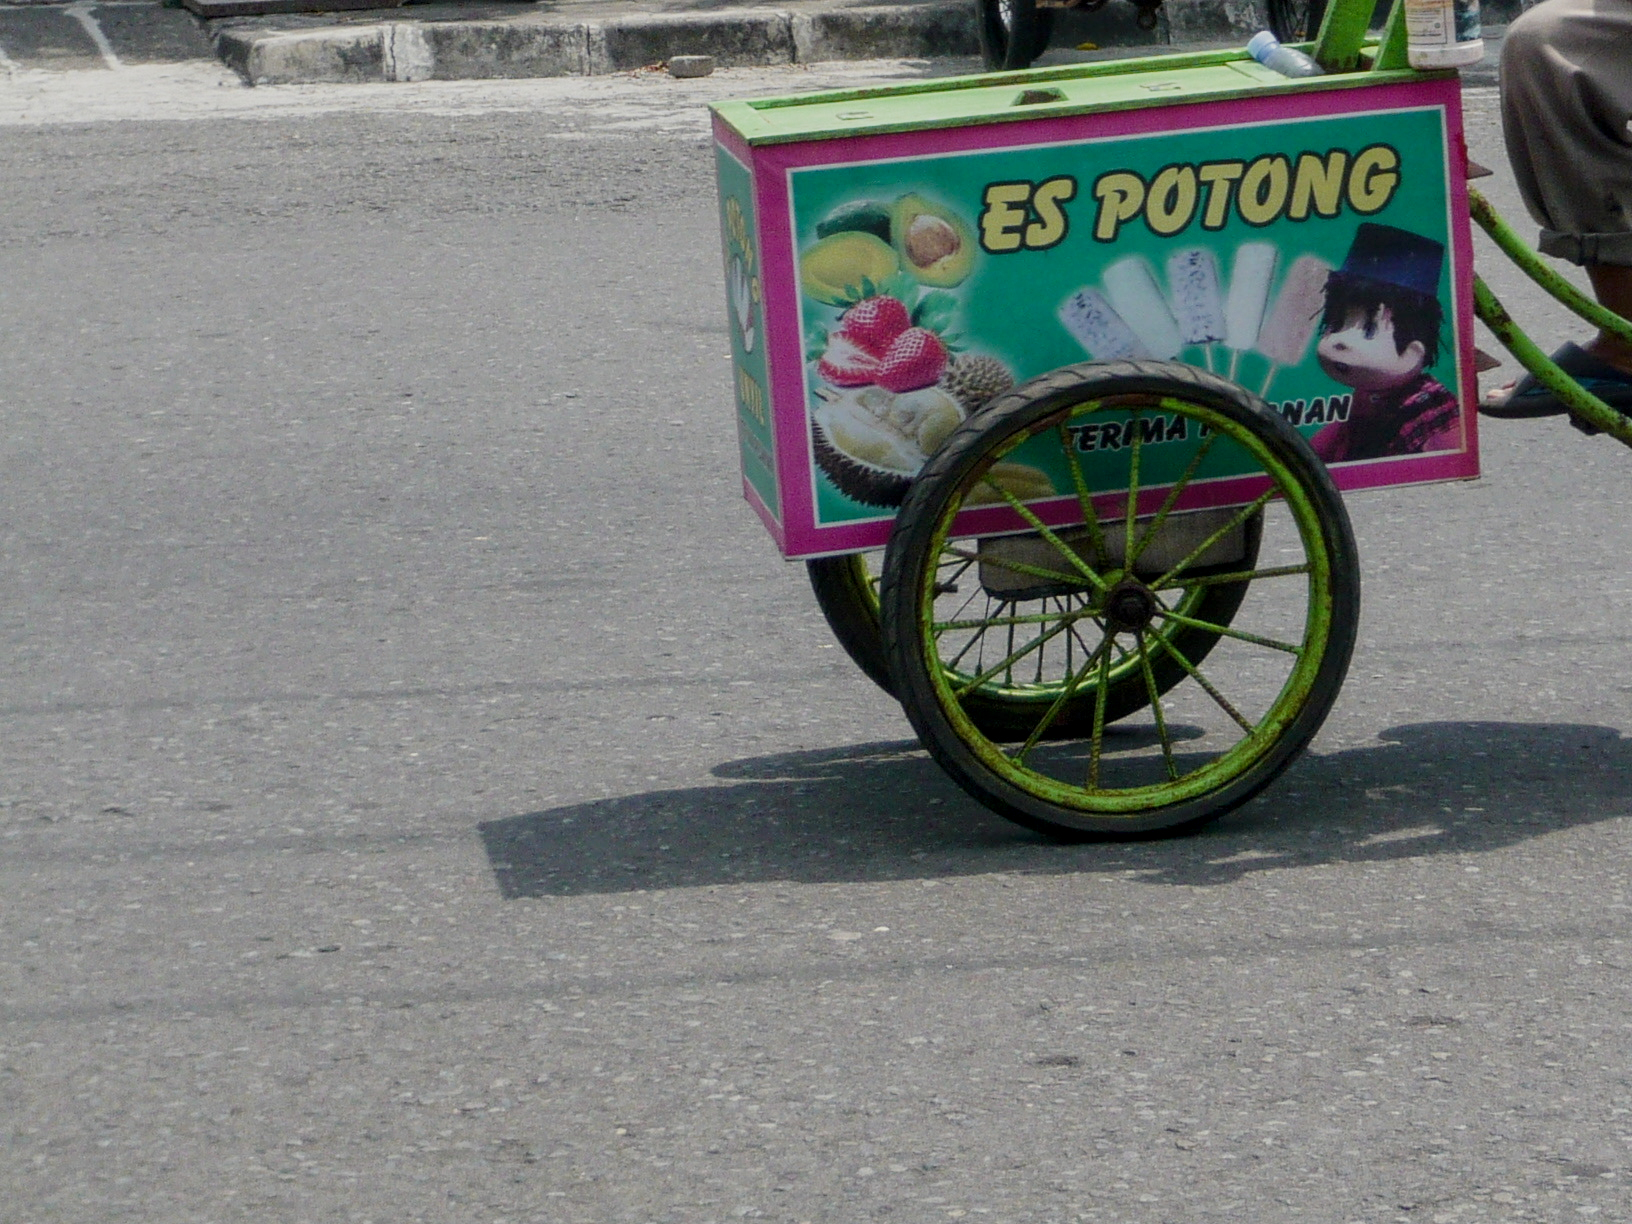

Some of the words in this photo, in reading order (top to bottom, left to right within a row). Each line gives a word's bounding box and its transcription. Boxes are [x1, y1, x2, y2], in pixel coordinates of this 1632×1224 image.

[979, 174, 1078, 254] ES
[1092, 142, 1401, 244] POTONG
[1063, 413, 1189, 453] TERIMA
